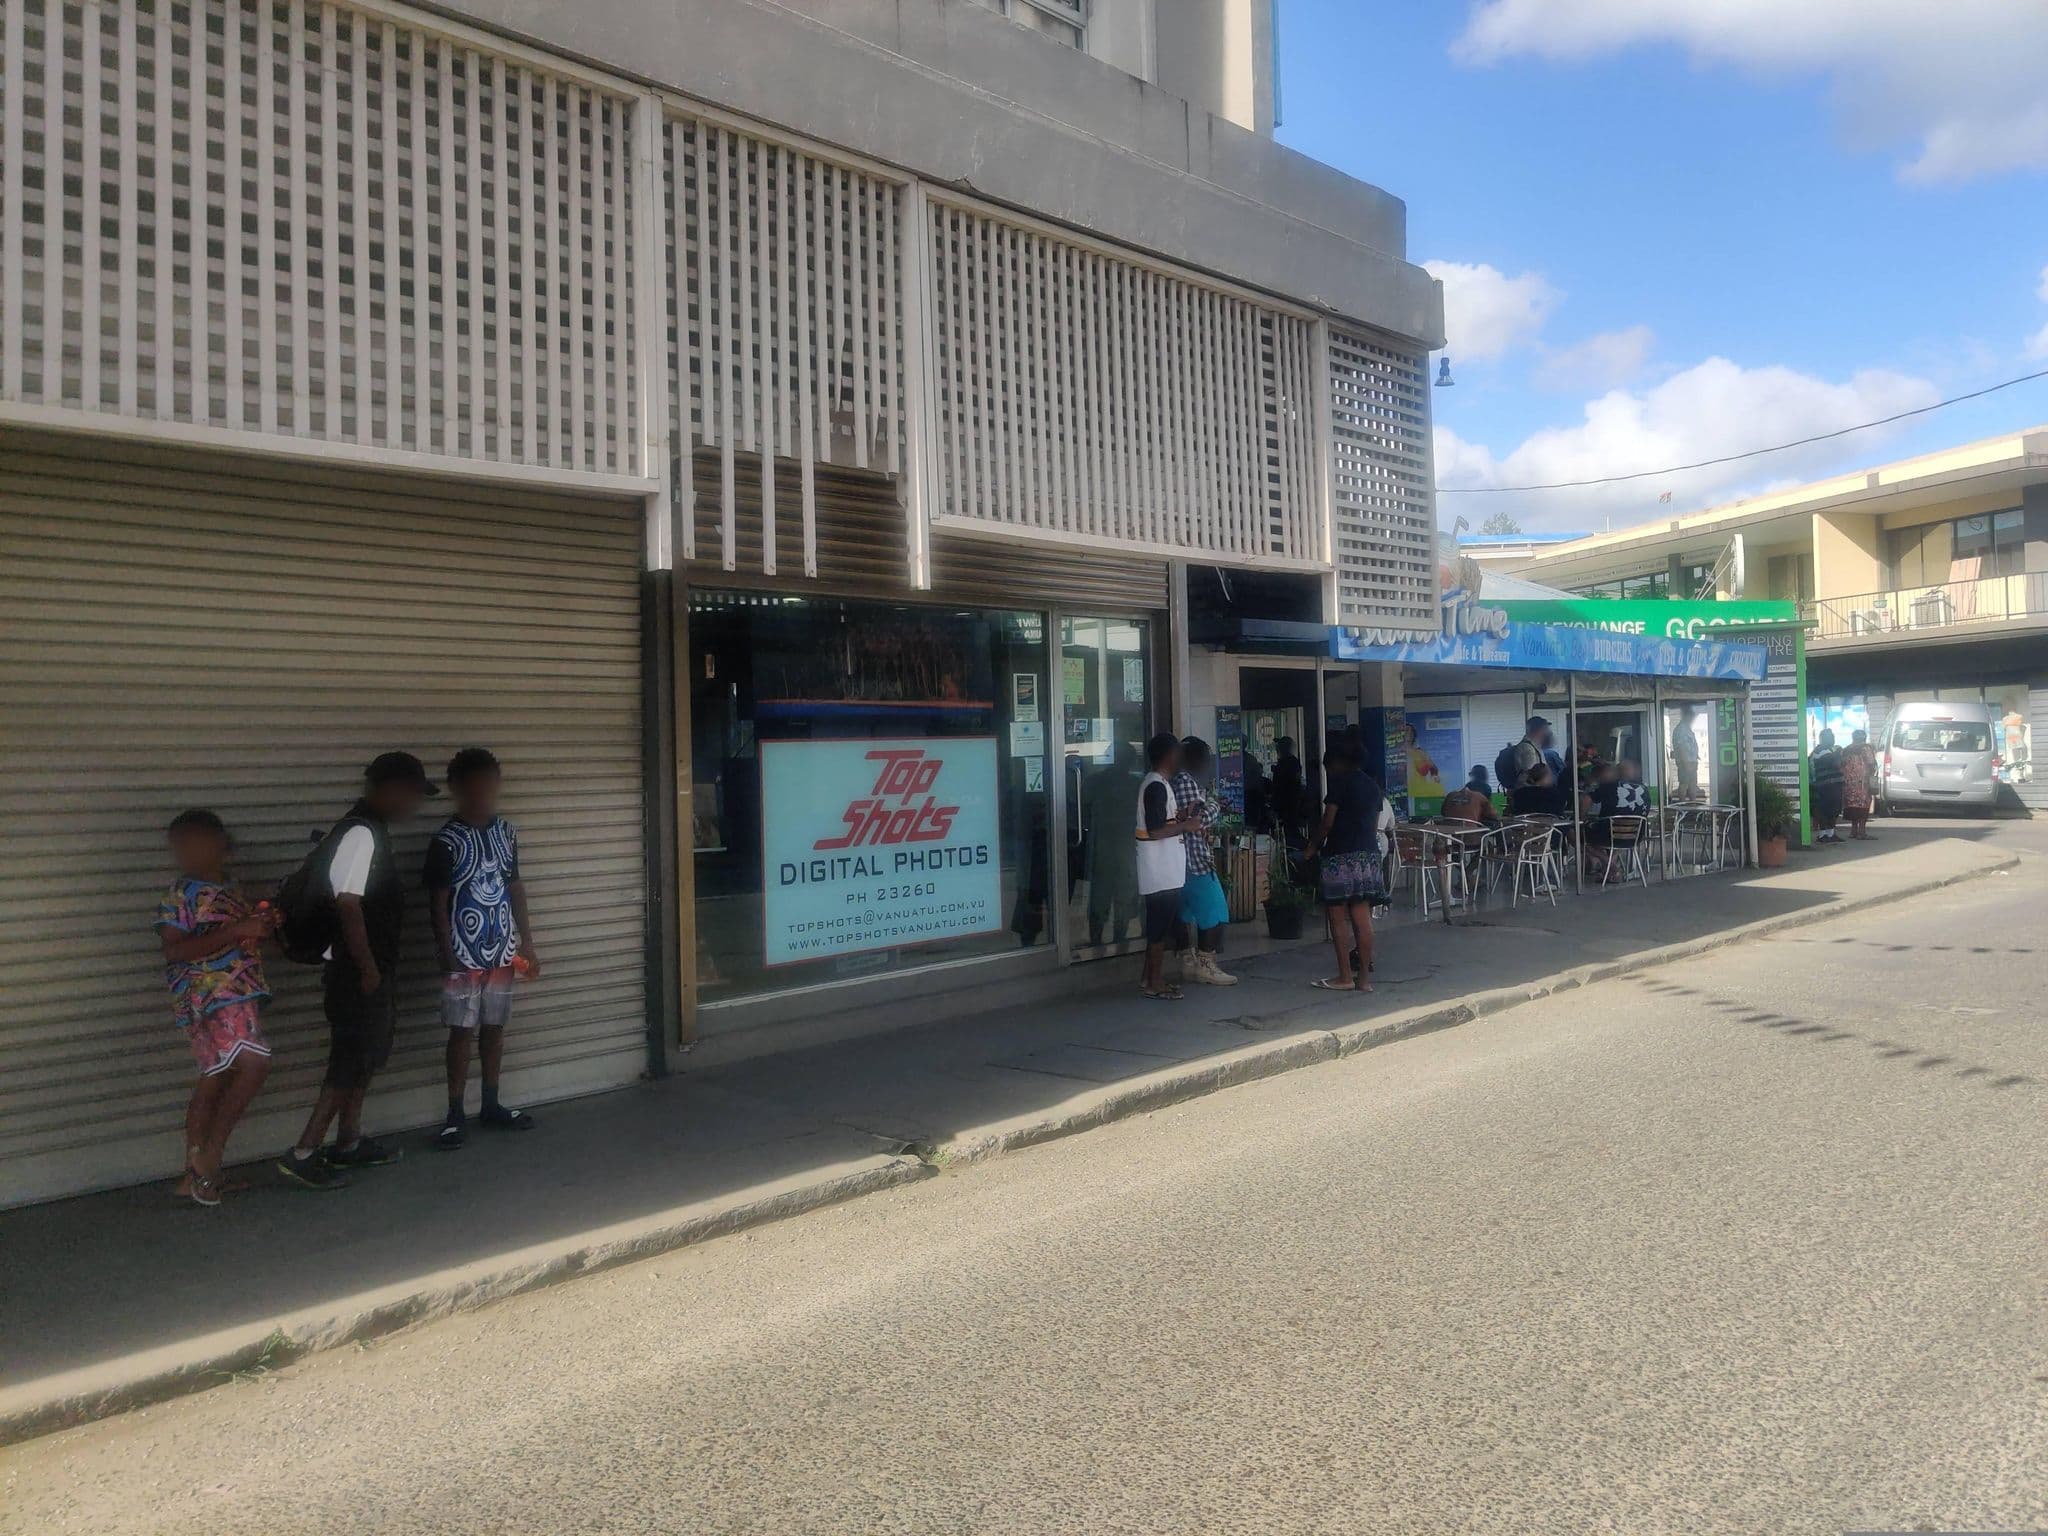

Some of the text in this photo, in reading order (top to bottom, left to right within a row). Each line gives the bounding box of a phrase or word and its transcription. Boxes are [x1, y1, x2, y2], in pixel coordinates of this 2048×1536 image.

[864, 750, 943, 805] Top
[813, 796, 960, 850] Shots
[780, 845, 988, 886] DIGITAL PHOTOS
[846, 882, 936, 905] PH 23260
[788, 900, 985, 934] TOPSHOTS@VANUATU.COM.VU
[788, 915, 986, 951] WWW.TOPSHOTSVANUATU.COM
